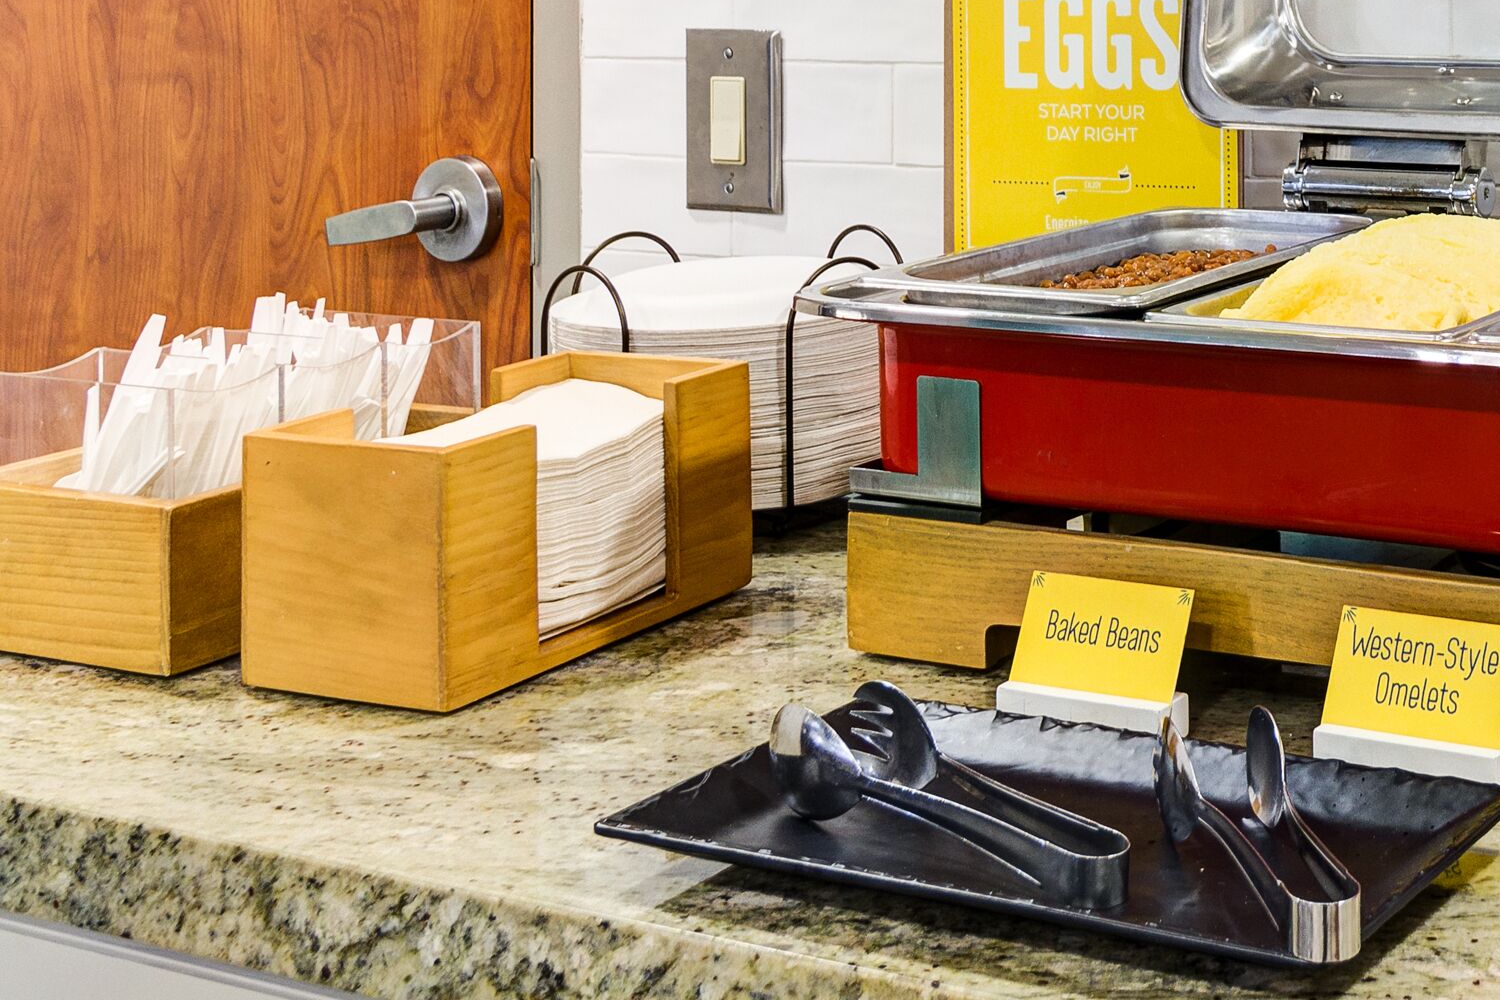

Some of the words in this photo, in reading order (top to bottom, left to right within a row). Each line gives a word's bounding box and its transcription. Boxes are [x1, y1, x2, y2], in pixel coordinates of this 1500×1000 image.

[1038, 103, 1092, 119] START
[1095, 104, 1145, 120] YOUR
[1046, 126, 1080, 141] DAY
[1084, 126, 1138, 142] RIGHT
[1045, 609, 1102, 646] Baked
[1105, 617, 1161, 653] Beans
[1352, 623, 1499, 681] Western-Style
[1375, 671, 1460, 715] Omelets
